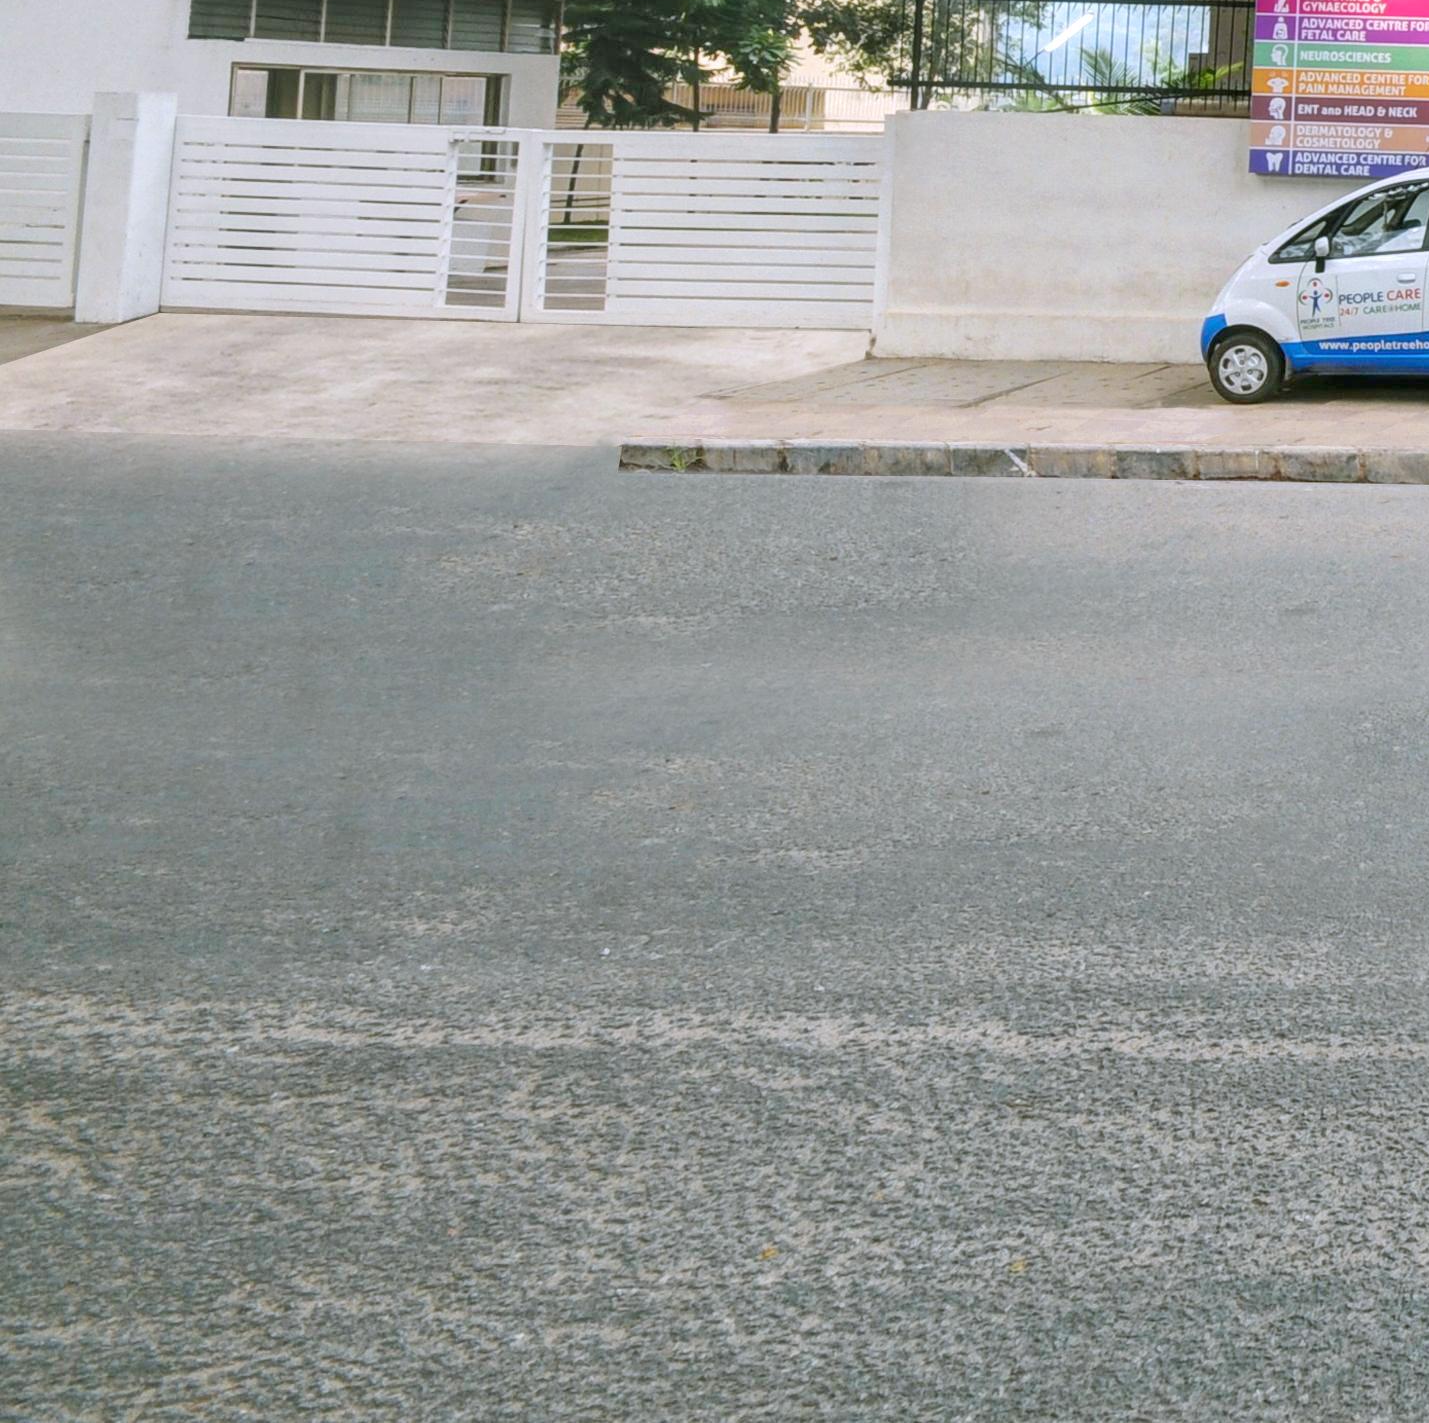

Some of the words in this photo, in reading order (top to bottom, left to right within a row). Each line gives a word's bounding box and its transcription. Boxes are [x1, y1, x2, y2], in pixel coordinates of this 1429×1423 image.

[1302, 2, 1387, 14] GYNAECOLOGY
[1302, 18, 1364, 30] ADVANCED
[1366, 20, 1408, 32] CENTRE
[1301, 29, 1334, 40] FETAL
[1336, 31, 1366, 42] CARE
[1300, 50, 1392, 63] NEUROSCIENCES
[1299, 72, 1361, 84] ADVANCED
[1364, 73, 1405, 85] CENTRE
[1408, 75, 1429, 85] FOR
[1298, 83, 1325, 94] PAIN
[1328, 84, 1406, 96] MANAGEMENT
[1297, 104, 1318, 115] ENT
[1344, 105, 1374, 116] HEAD
[1377, 107, 1386, 117] &
[1388, 107, 1417, 118] NECK
[1296, 126, 1381, 138] DERMATOLOGY
[1384, 128, 1393, 138] &
[1296, 137, 1381, 149] COSMETOLOGY
[1295, 152, 1357, 164] ADVANCED
[1359, 154, 1402, 165] CENTRE
[1405, 155, 1426, 166] FOR
[1295, 163, 1338, 174] DENTAL
[1341, 165, 1370, 176] CARE
[1339, 291, 1384, 305] PEOPLE
[1386, 288, 1421, 301] CARE
[1340, 307, 1359, 316] 24/7
